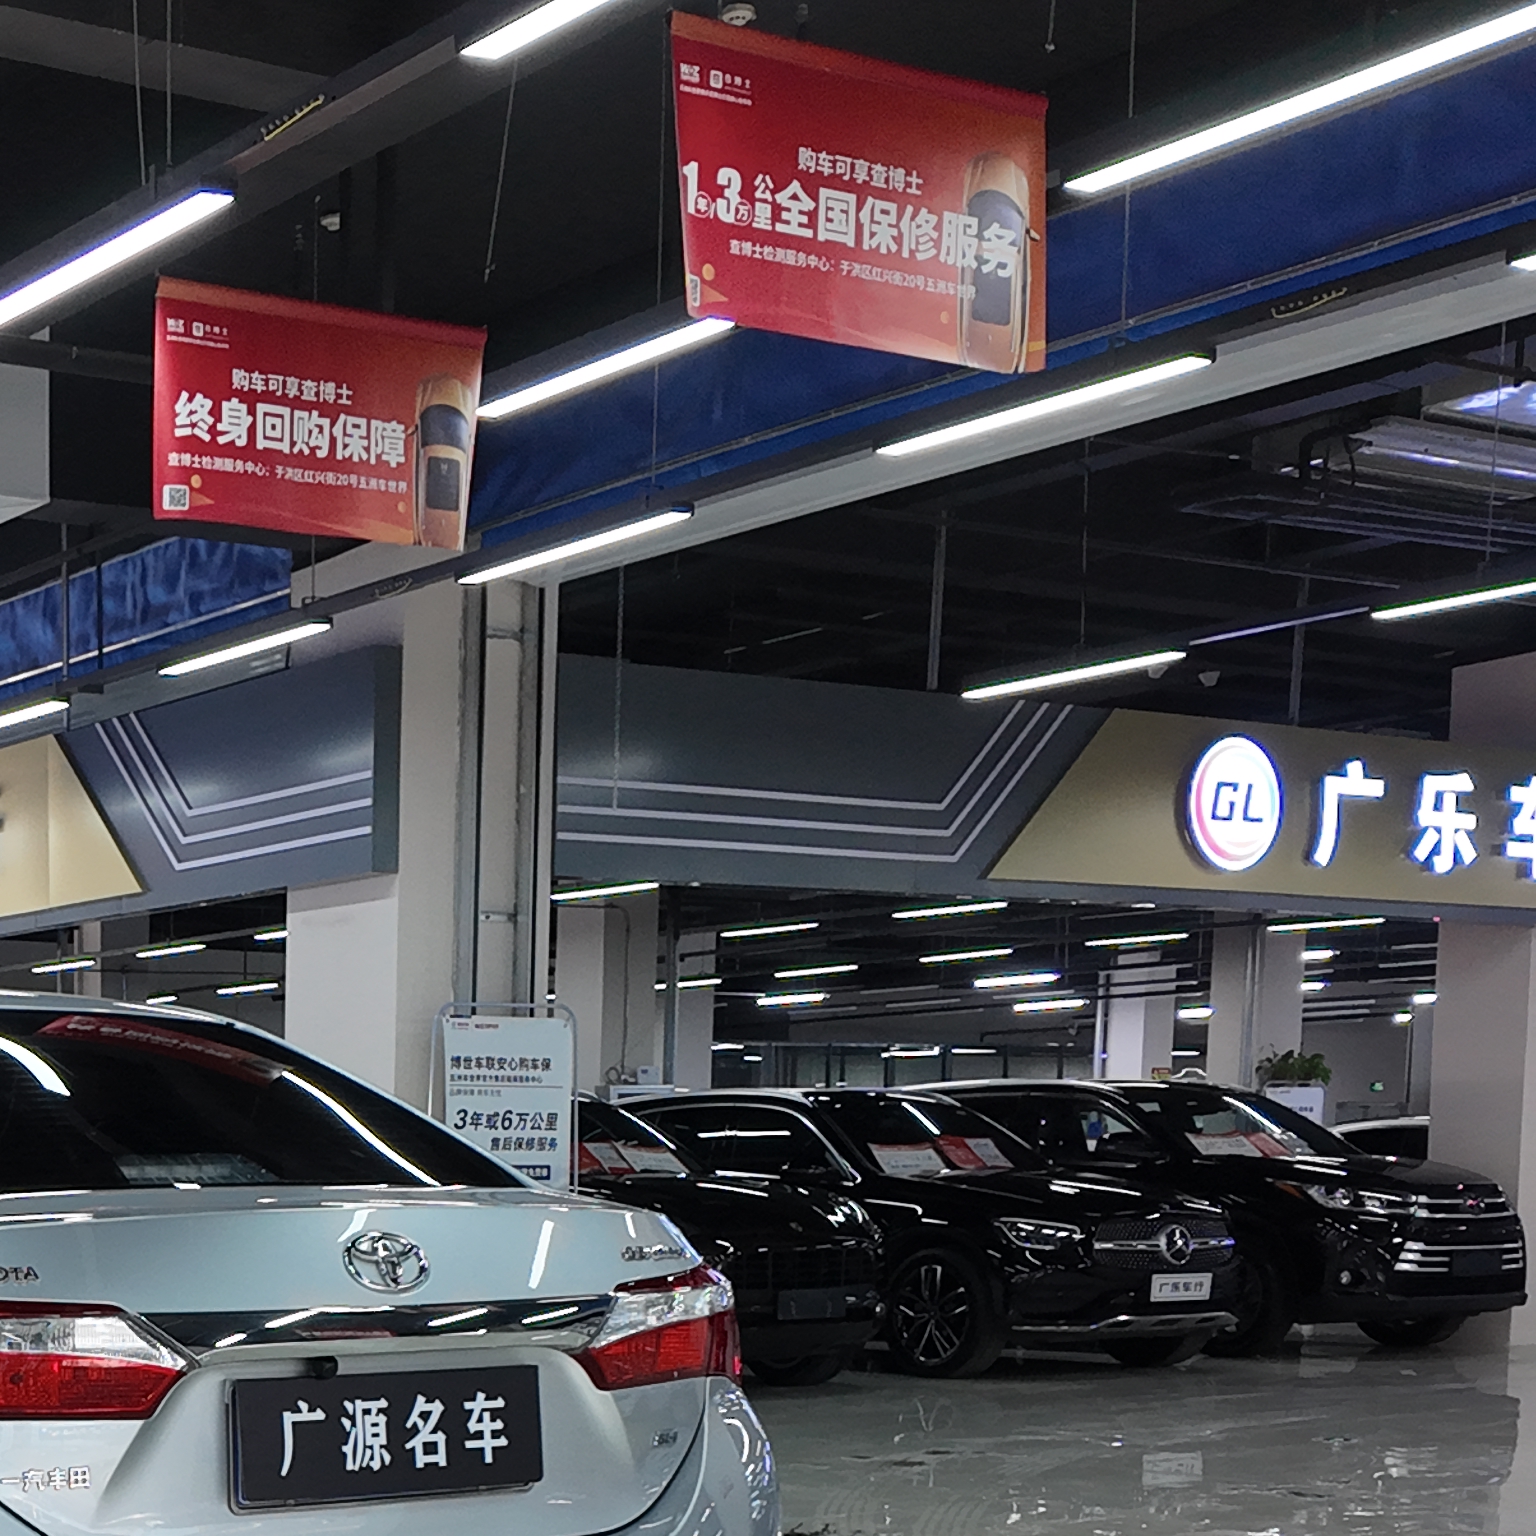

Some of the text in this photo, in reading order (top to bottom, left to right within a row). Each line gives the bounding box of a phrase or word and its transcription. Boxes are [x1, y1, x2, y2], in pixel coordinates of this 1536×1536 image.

[798, 147, 924, 196] 购车可享查博士
[231, 368, 353, 405] 购车可享查博士
[174, 391, 406, 468] 终身回购保障
[454, 1108, 559, 1131] 3年或6万公里
[280, 1390, 509, 1478] 广源名车
[0, 1466, 91, 1491] 一汽丰田
